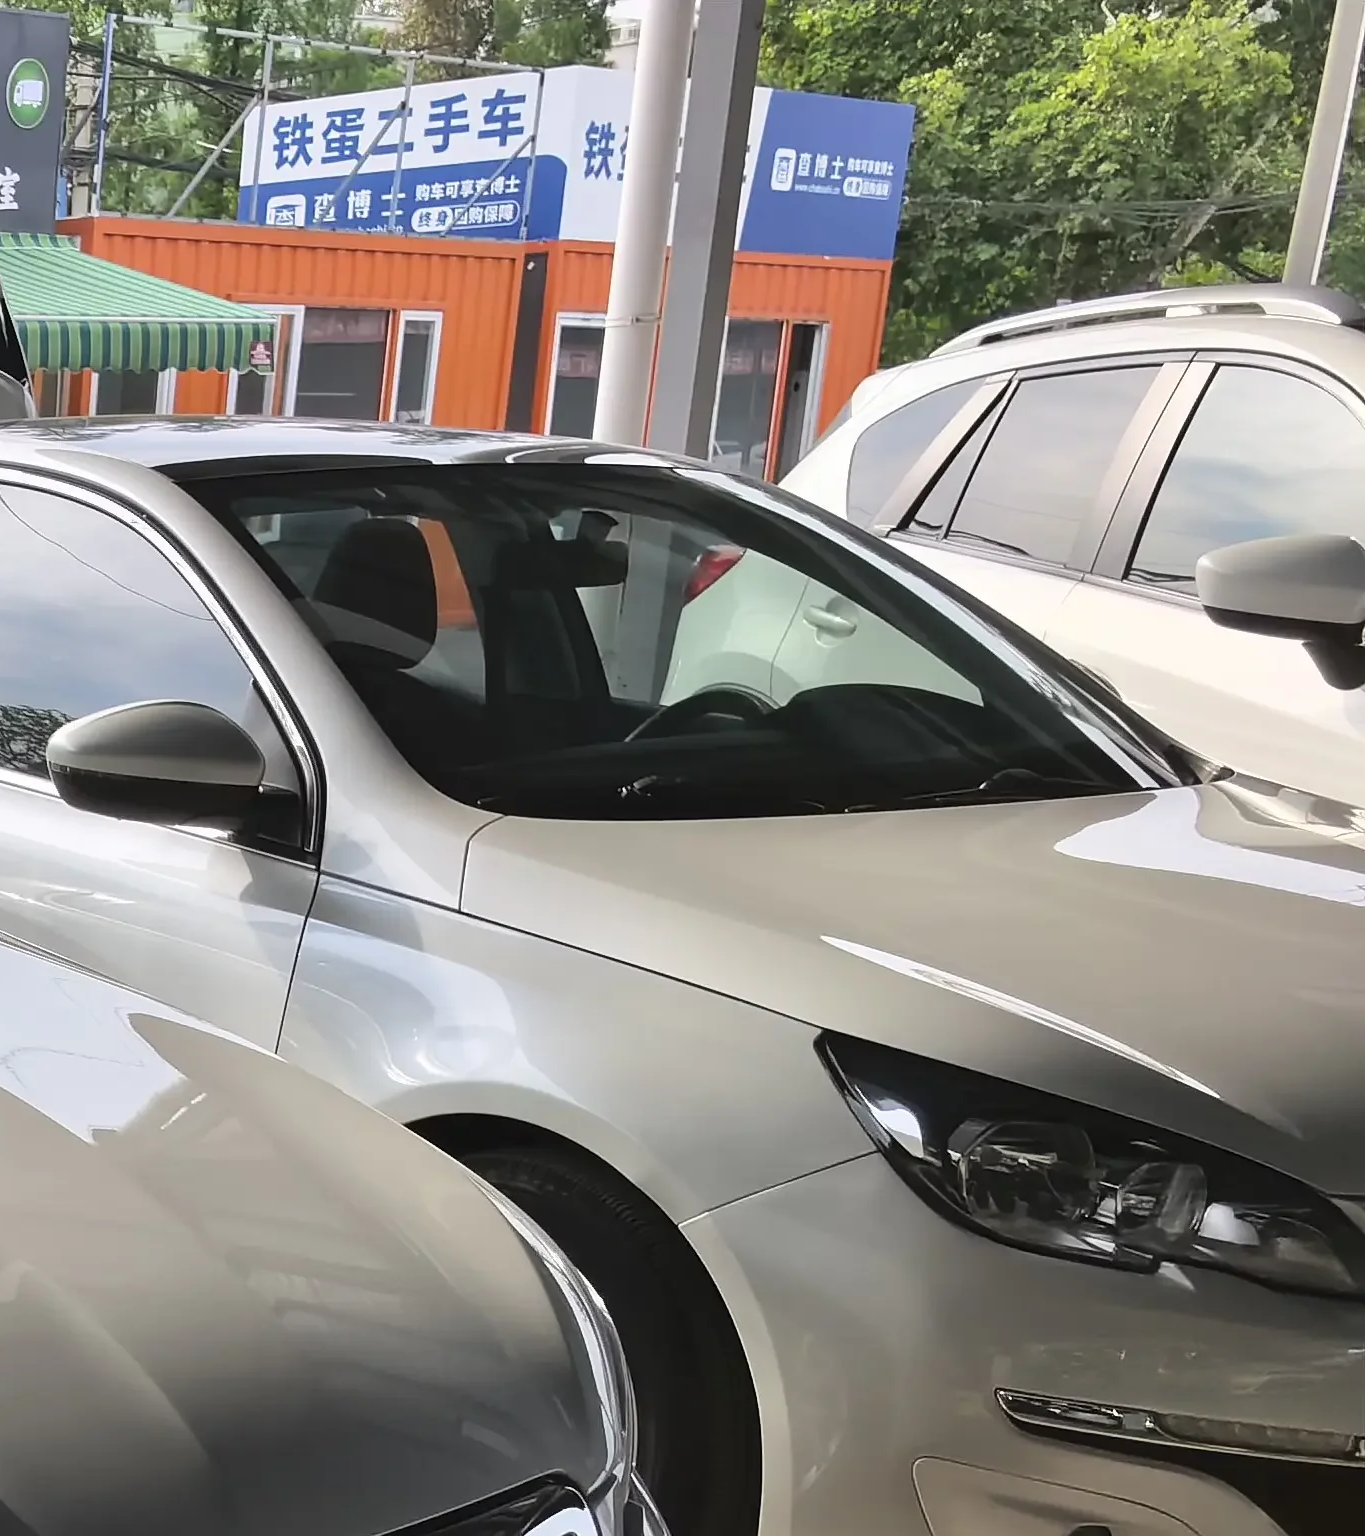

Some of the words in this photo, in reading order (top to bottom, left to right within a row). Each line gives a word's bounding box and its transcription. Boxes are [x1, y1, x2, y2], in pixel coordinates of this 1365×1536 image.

[272, 88, 527, 170] 铁蛋二手车
[583, 120, 631, 181] 铁
[797, 152, 845, 180] 查博士
[313, 187, 406, 222] 查博士
